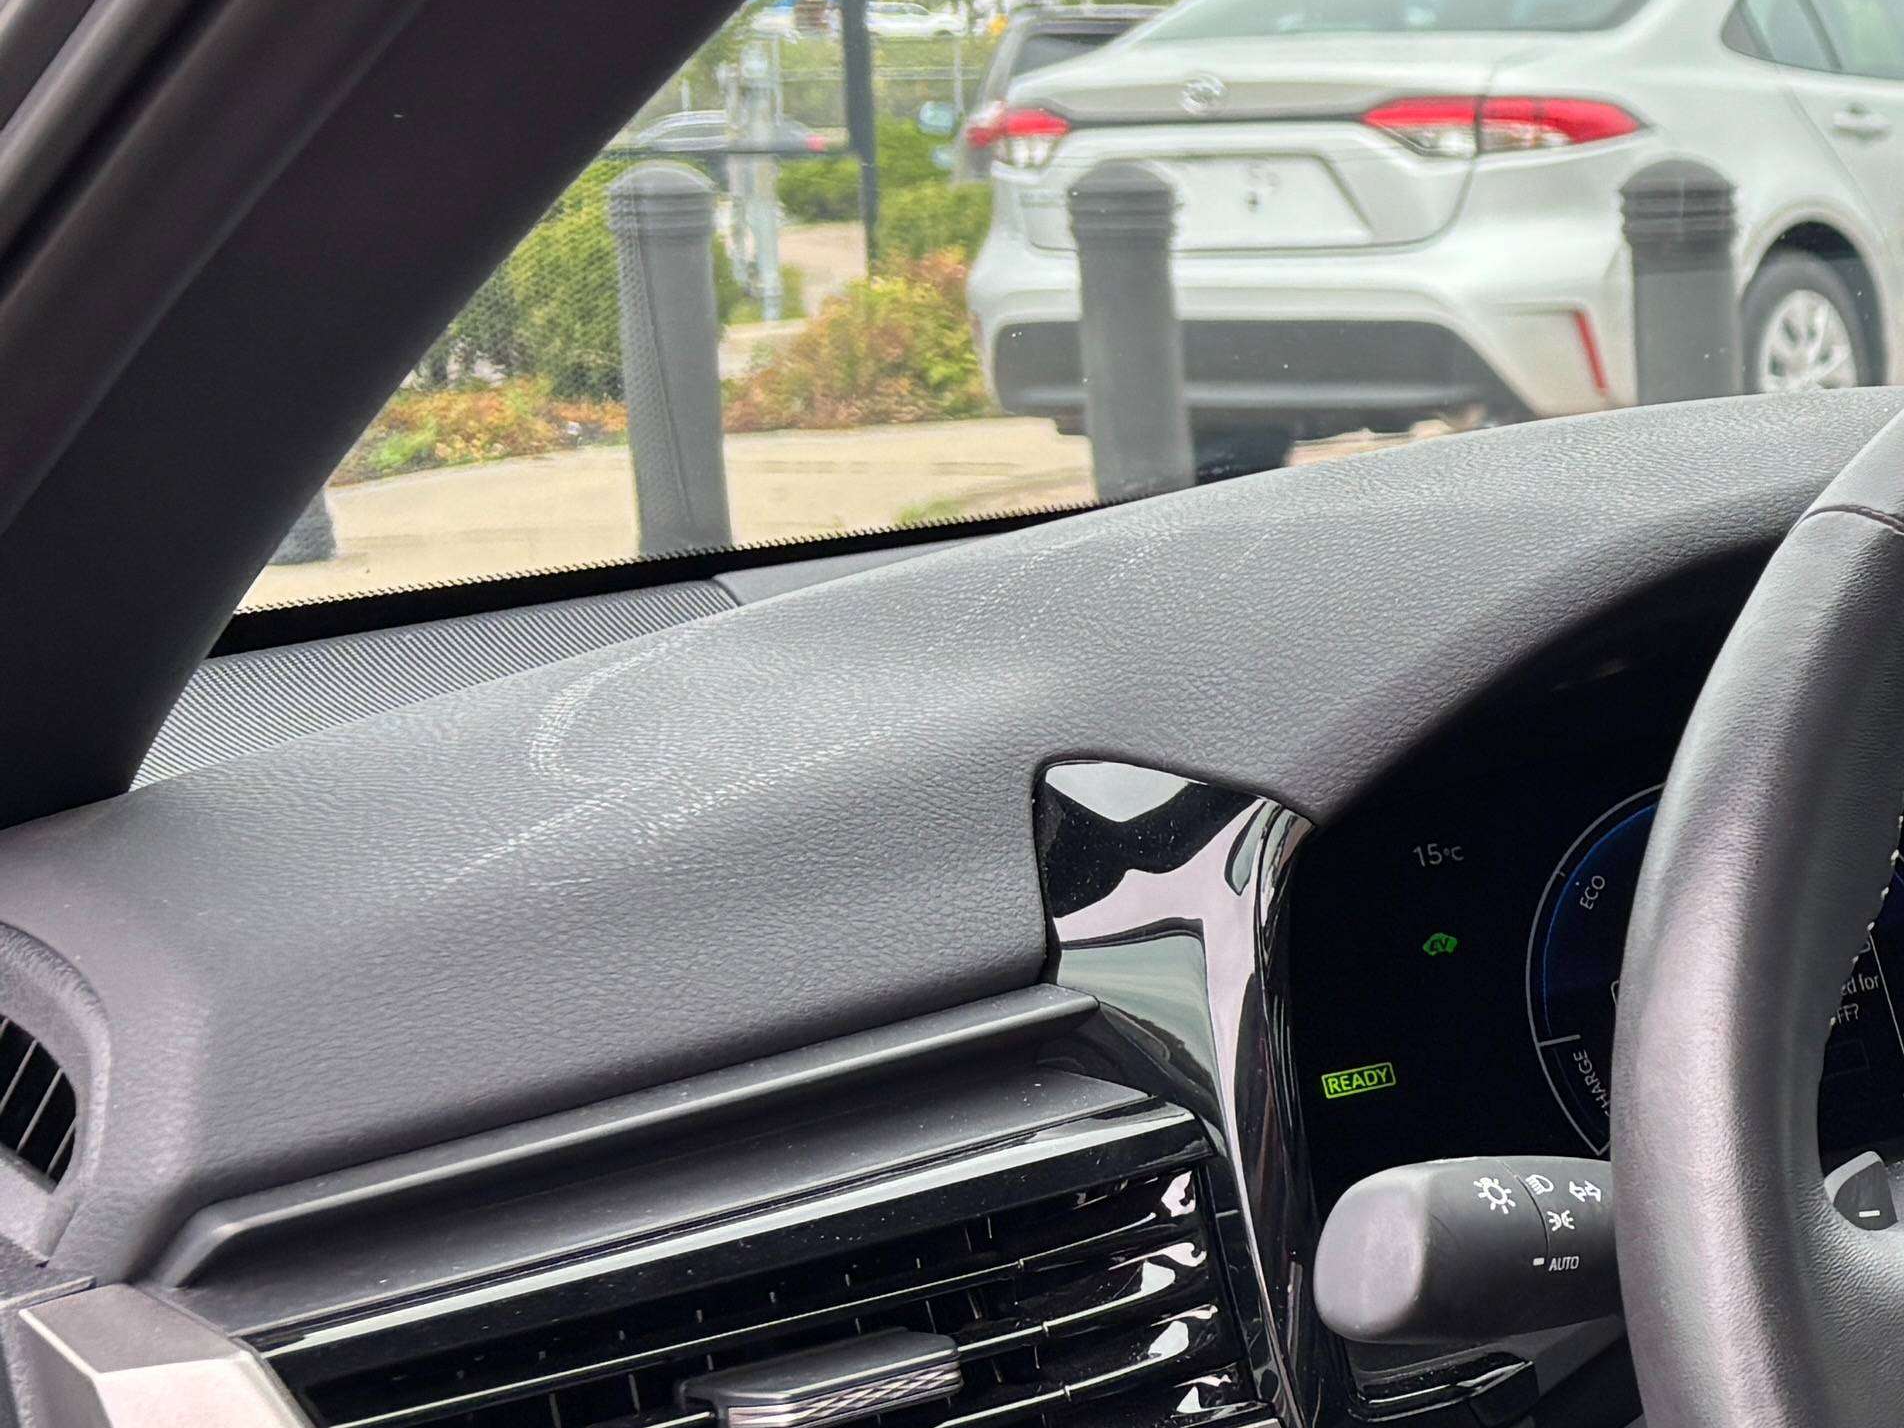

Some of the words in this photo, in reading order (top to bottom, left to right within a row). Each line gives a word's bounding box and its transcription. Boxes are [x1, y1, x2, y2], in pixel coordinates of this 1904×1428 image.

[1579, 874, 1606, 911] ECO
[1327, 1066, 1388, 1094] READY
[1548, 1255, 1580, 1272] AUTO
